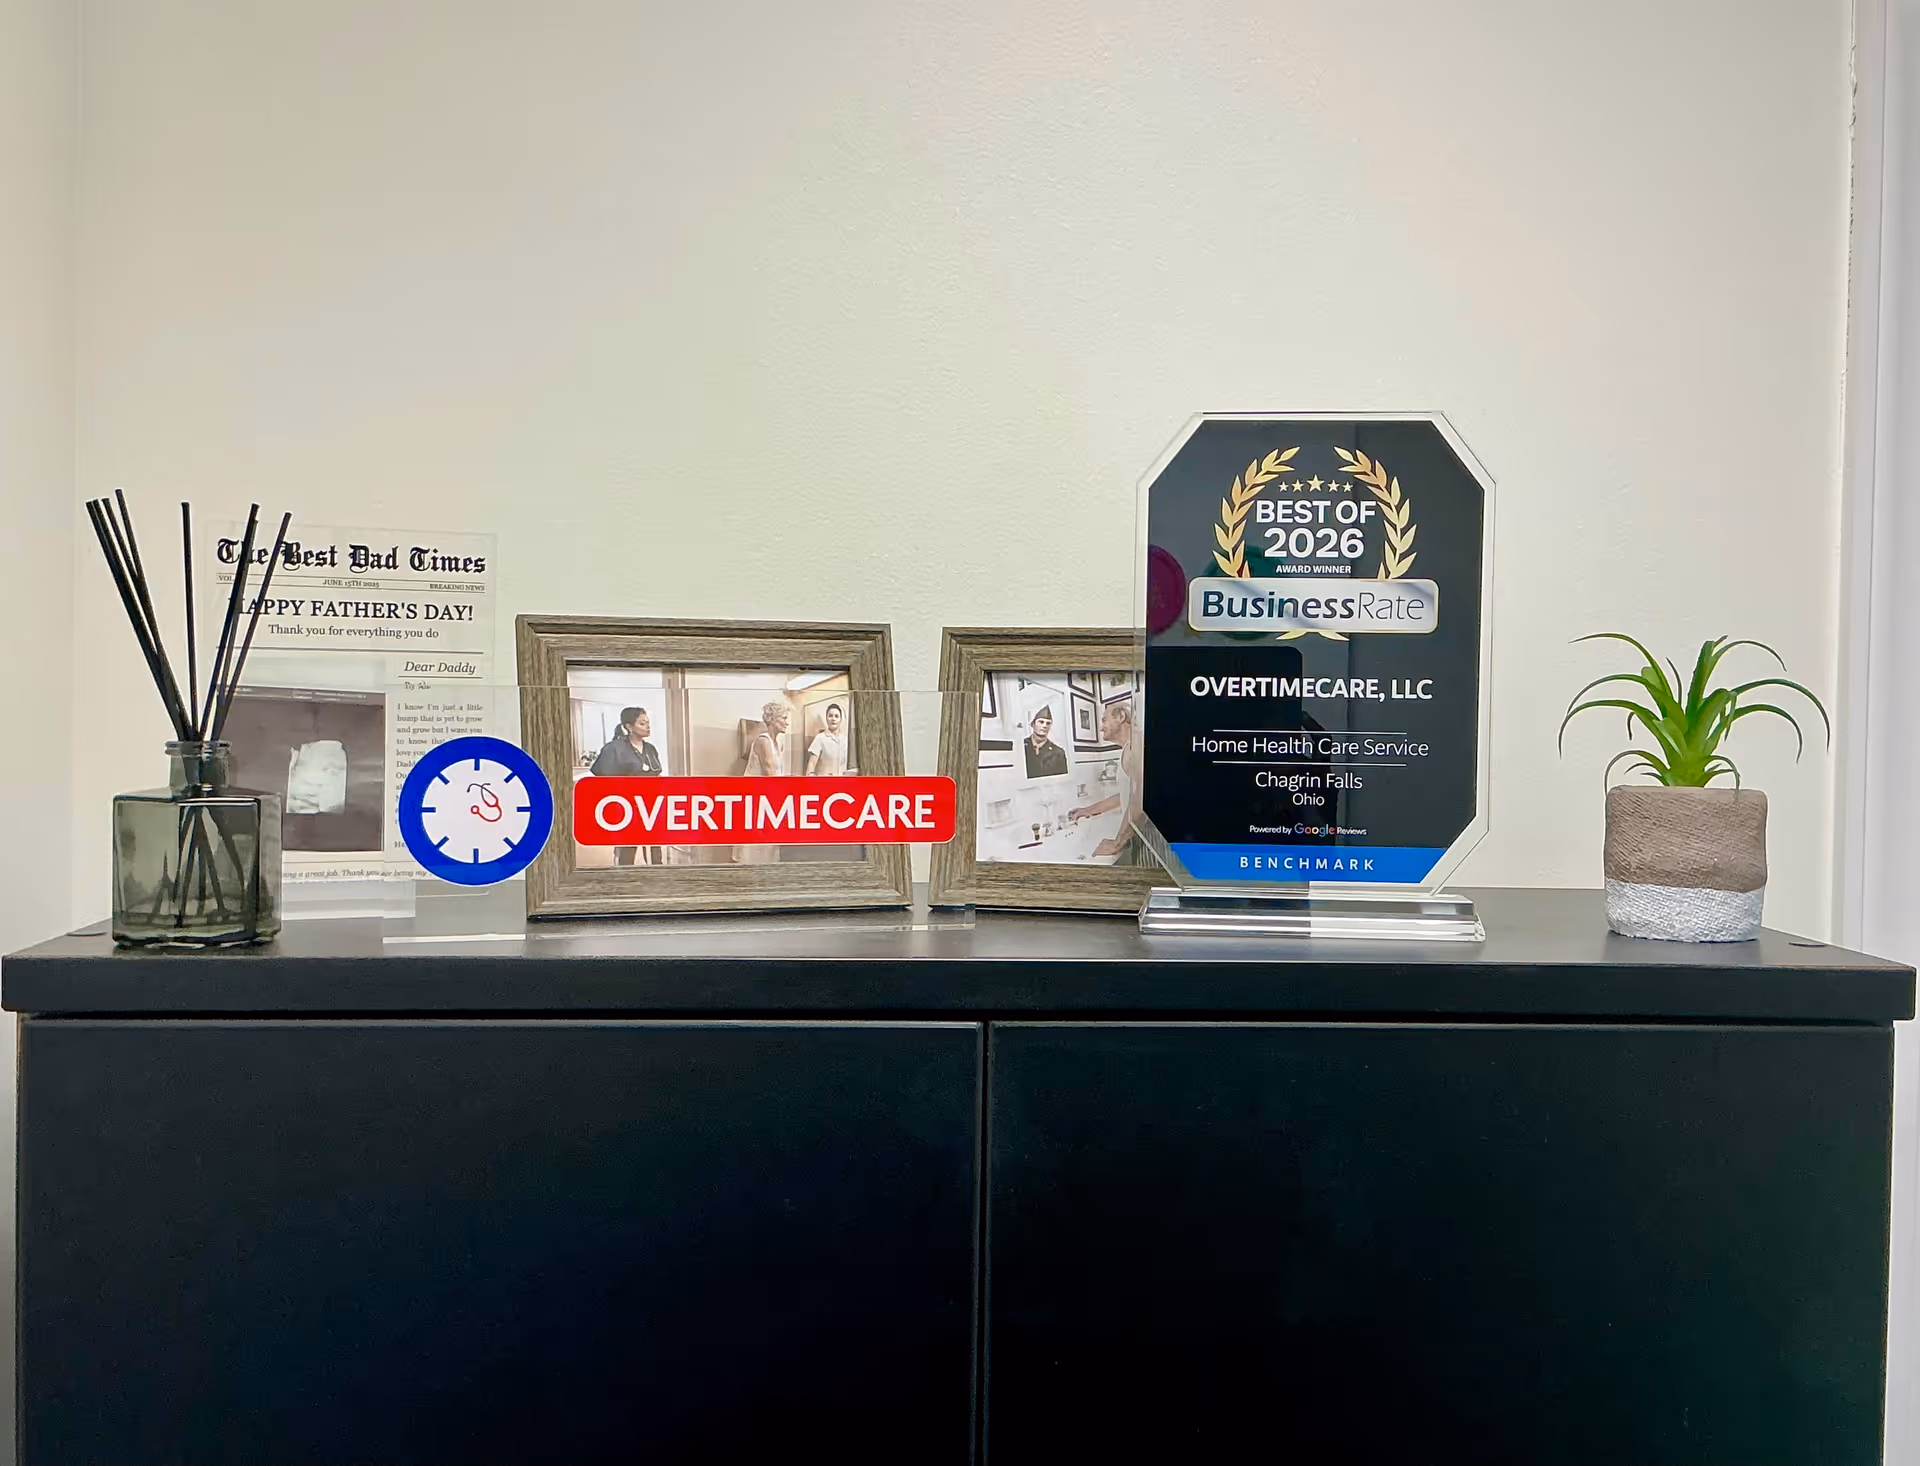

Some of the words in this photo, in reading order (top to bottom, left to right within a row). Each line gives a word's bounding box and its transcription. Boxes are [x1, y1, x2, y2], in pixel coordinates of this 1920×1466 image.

[1256, 500, 1331, 524] BEST
[1335, 500, 1376, 524] OF
[1264, 528, 1365, 558] 2026
[280, 541, 338, 571] Best
[348, 544, 400, 574] Dad
[409, 547, 486, 573] Times
[1275, 564, 1312, 574] AWARD
[1313, 564, 1351, 574] WINNER
[311, 600, 417, 620] FATHER'S
[424, 603, 473, 621] DAY!
[1202, 591, 1424, 620] BusinessRate
[268, 624, 303, 635] Thank
[306, 627, 326, 637] you
[328, 625, 345, 636] for
[347, 627, 402, 639] everything
[404, 630, 423, 639] you
[426, 628, 439, 638] do
[404, 661, 435, 672] Dear
[437, 662, 476, 675] Daddy
[1190, 676, 1385, 702] OVERTIMECARE,
[1391, 679, 1433, 699] LLC
[404, 703, 424, 711] know
[442, 704, 456, 712] just
[467, 703, 483, 711] little
[465, 716, 483, 724] grow
[412, 727, 430, 735] grow
[409, 737, 427, 745] know
[1192, 736, 1248, 754] Home
[1253, 737, 1313, 754] Health
[1318, 738, 1359, 755] Care
[1364, 739, 1429, 756] Service
[1255, 772, 1321, 792] Chagrin
[1326, 773, 1363, 789] Falls
[1292, 793, 1325, 806] Ohio
[594, 793, 935, 831] OVERTIMECARE
[1250, 825, 1281, 834] Powered
[1282, 825, 1292, 835] by
[1294, 823, 1335, 837] Google
[1337, 826, 1367, 835] Reviews
[1239, 856, 1374, 871] BENCHMARK
[304, 870, 325, 879] great
[325, 868, 339, 878] job.
[342, 868, 364, 877] Thank
[415, 870, 427, 878] my
